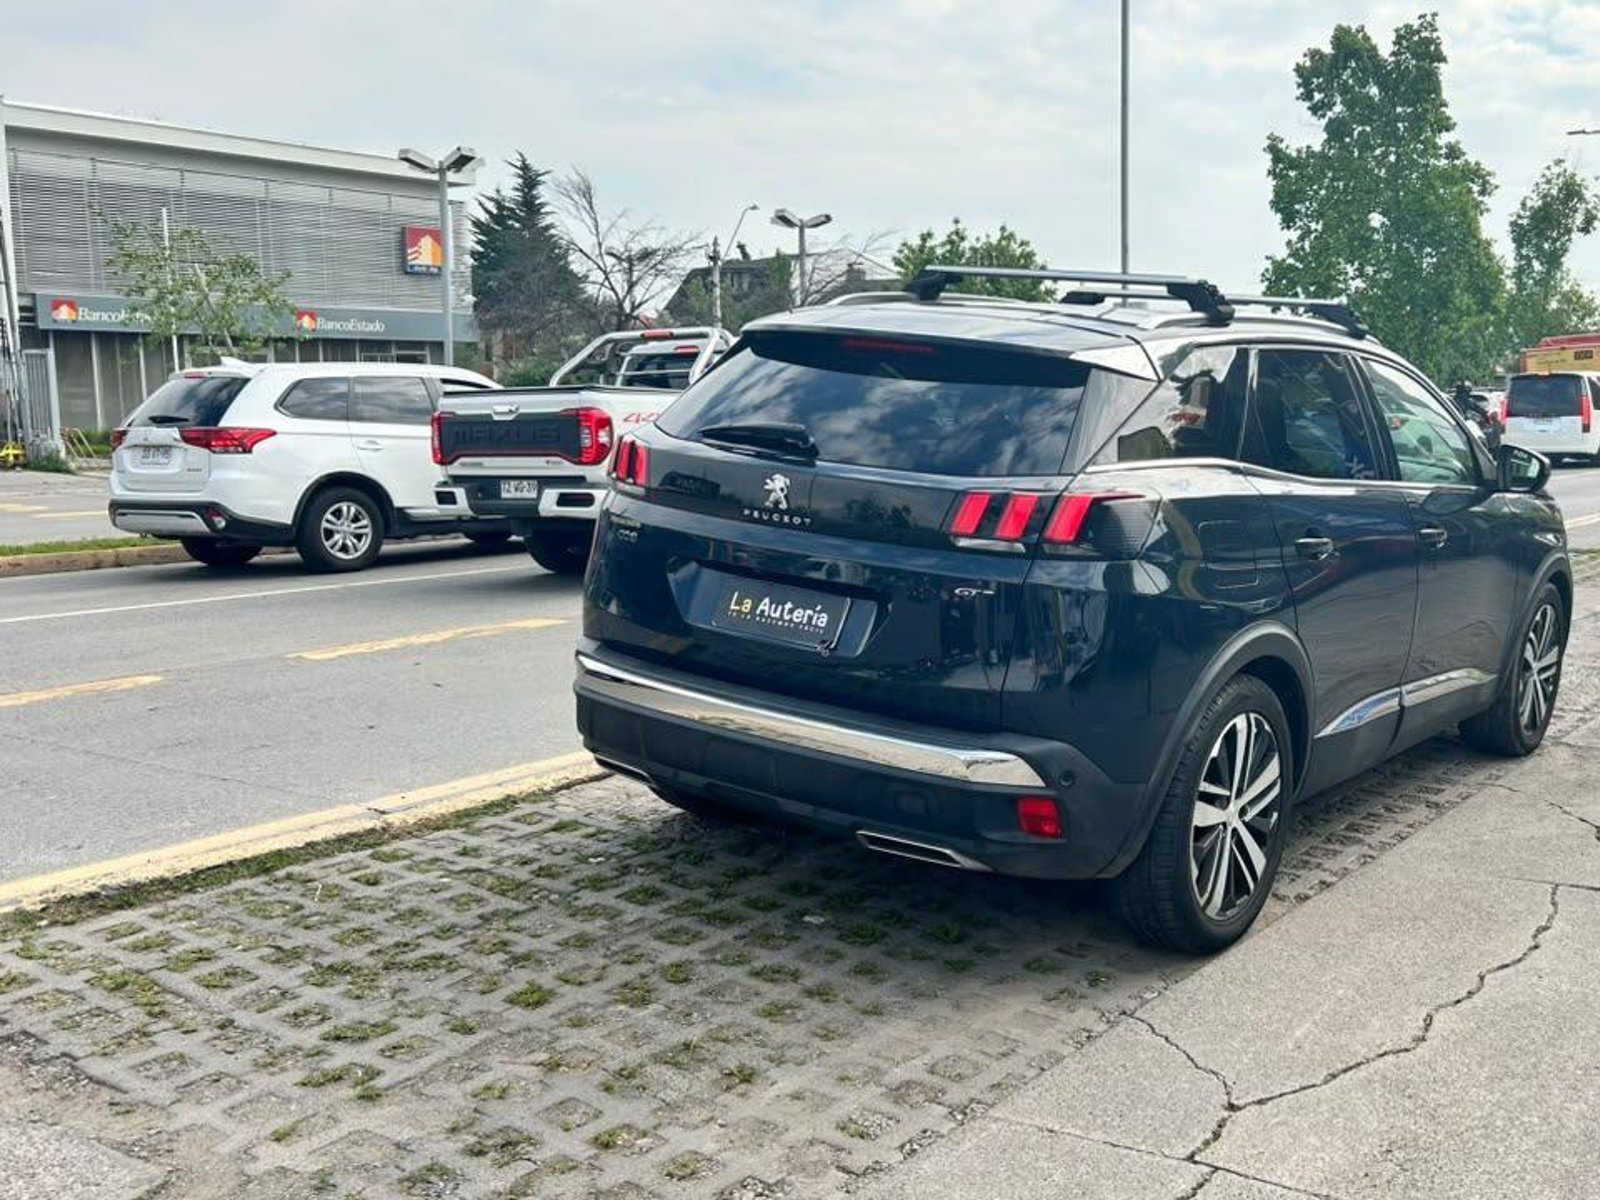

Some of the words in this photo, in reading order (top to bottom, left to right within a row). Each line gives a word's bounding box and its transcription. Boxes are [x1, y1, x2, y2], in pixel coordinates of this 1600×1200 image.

[317, 317, 386, 332] BancoEstado
[743, 508, 812, 526] PEUGEOT
[729, 591, 753, 612] La
[755, 596, 829, 628] Autería
